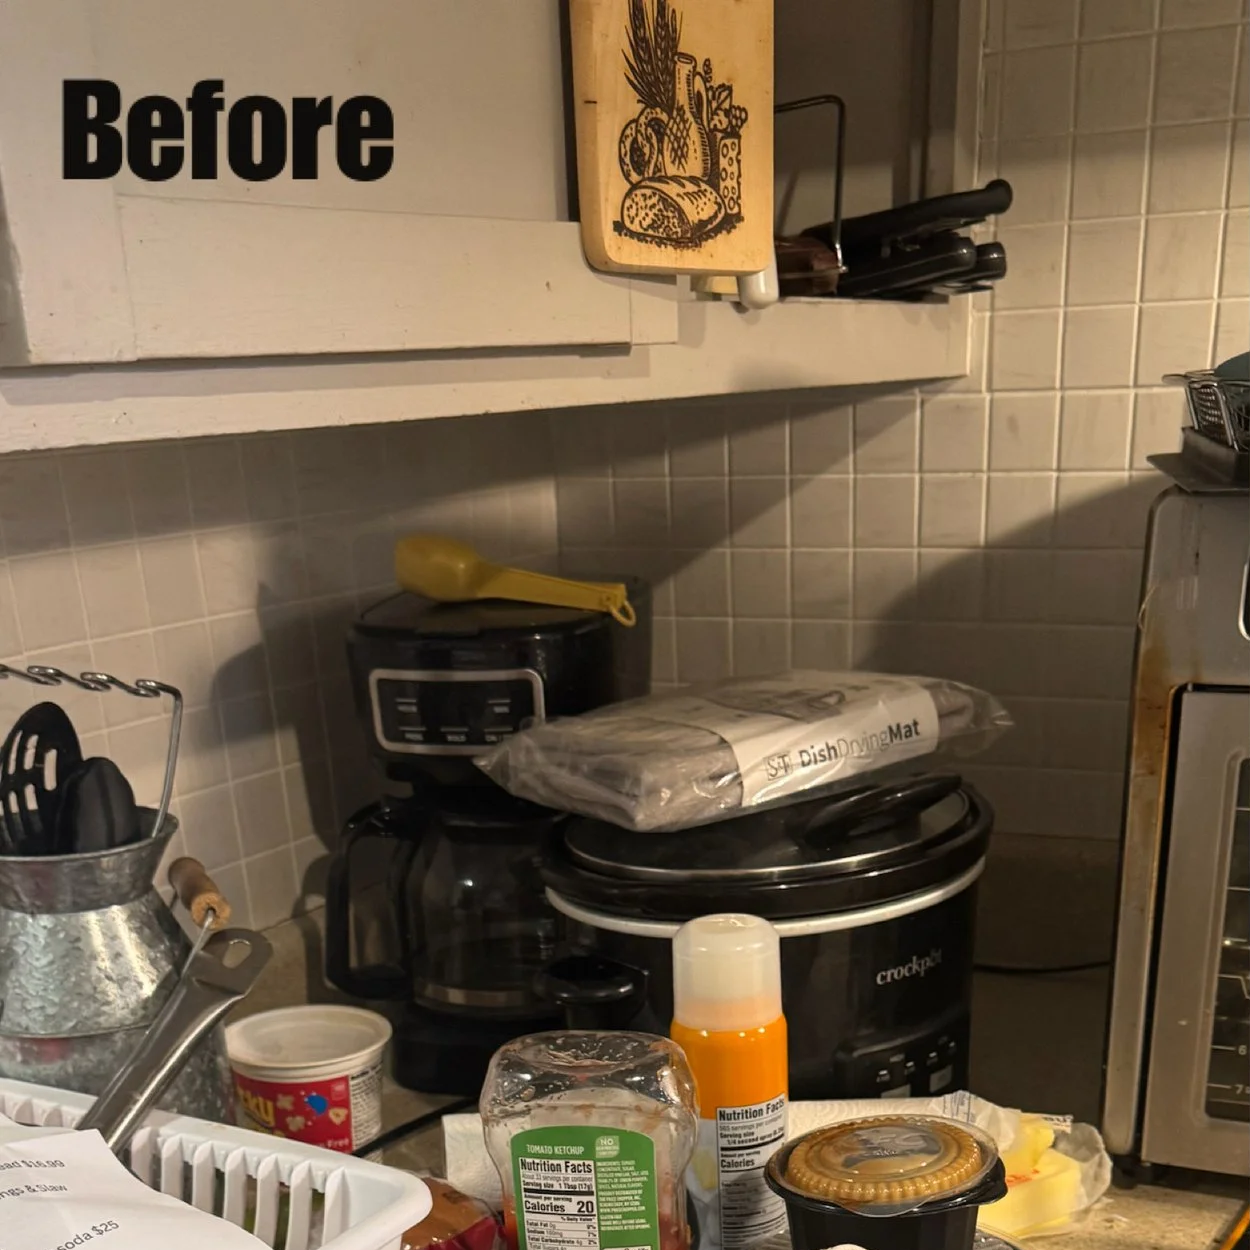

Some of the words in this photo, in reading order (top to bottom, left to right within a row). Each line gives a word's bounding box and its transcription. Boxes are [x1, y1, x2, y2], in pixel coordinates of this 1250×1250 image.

[876, 949, 942, 985] crockpot
[1238, 1045, 1247, 1055] 6
[1235, 1085, 1243, 1094] 7
[719, 1107, 763, 1121] Nutrition
[600, 1138, 614, 1146] NO
[526, 1143, 553, 1155] TOMATO
[553, 1145, 585, 1156] KETCHUP
[520, 1158, 562, 1173] Nutrition
[564, 1160, 593, 1174] Facts
[720, 1157, 755, 1169] Calories
[525, 1200, 565, 1213] Calories
[577, 1200, 594, 1213] 20
[91, 1220, 120, 1236] $25
